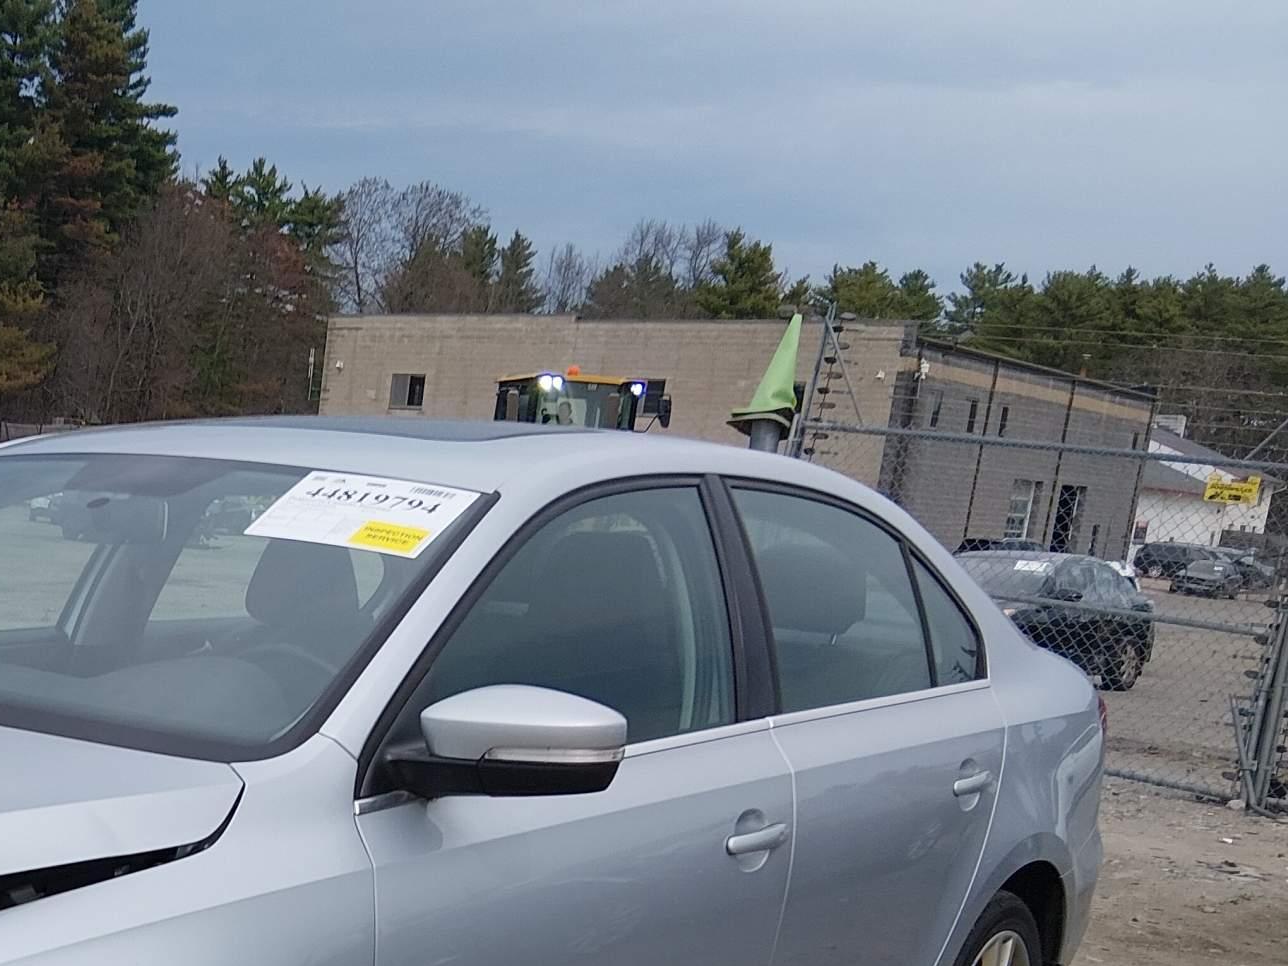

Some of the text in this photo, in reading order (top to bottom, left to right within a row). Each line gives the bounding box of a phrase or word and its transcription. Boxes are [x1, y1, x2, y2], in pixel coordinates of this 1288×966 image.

[305, 486, 441, 514] 44819794
[364, 526, 425, 542] INSPECTION
[365, 533, 410, 545] SERVICE
